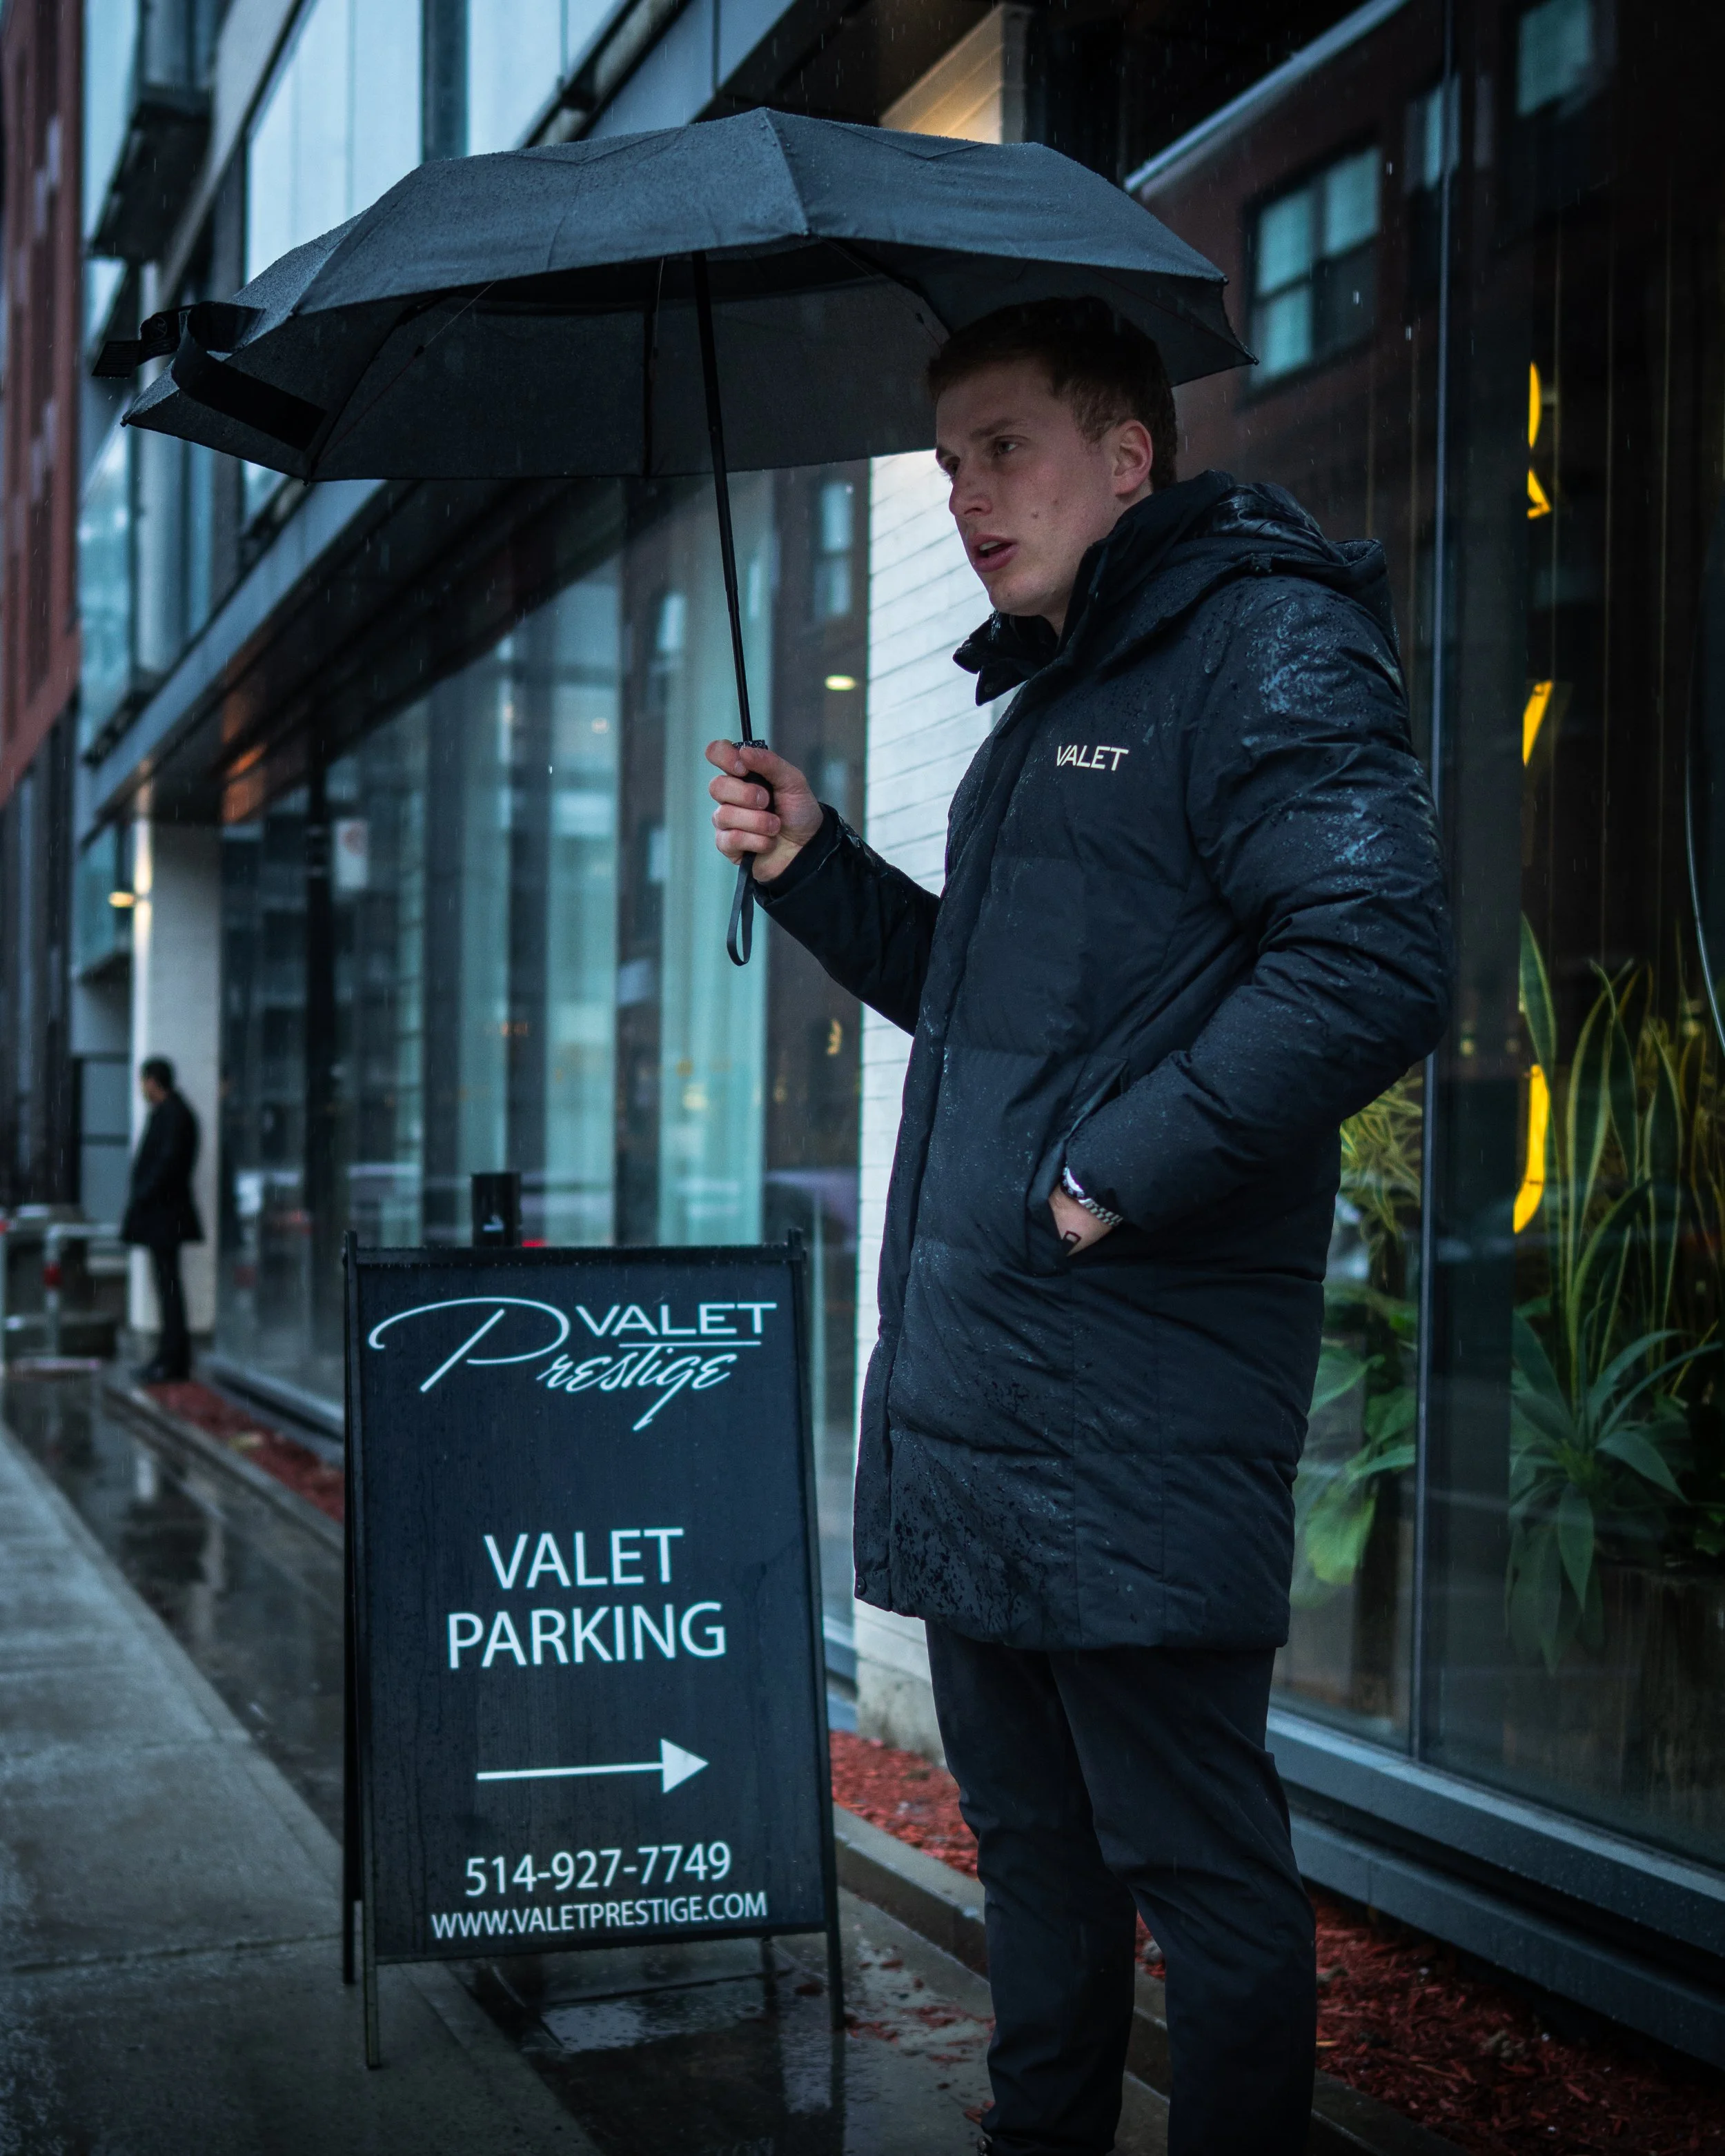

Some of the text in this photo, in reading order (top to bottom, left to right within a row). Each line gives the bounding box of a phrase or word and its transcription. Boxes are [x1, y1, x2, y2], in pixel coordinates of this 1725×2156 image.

[1056, 744, 1130, 771] VALET
[575, 1303, 778, 1337] VALET
[484, 1527, 683, 1590] VALET
[448, 1601, 726, 1669] PARKING
[465, 1841, 731, 1897] 514-927-7749
[431, 1891, 767, 1939] WWW.VALETPRESTIGE.COM
